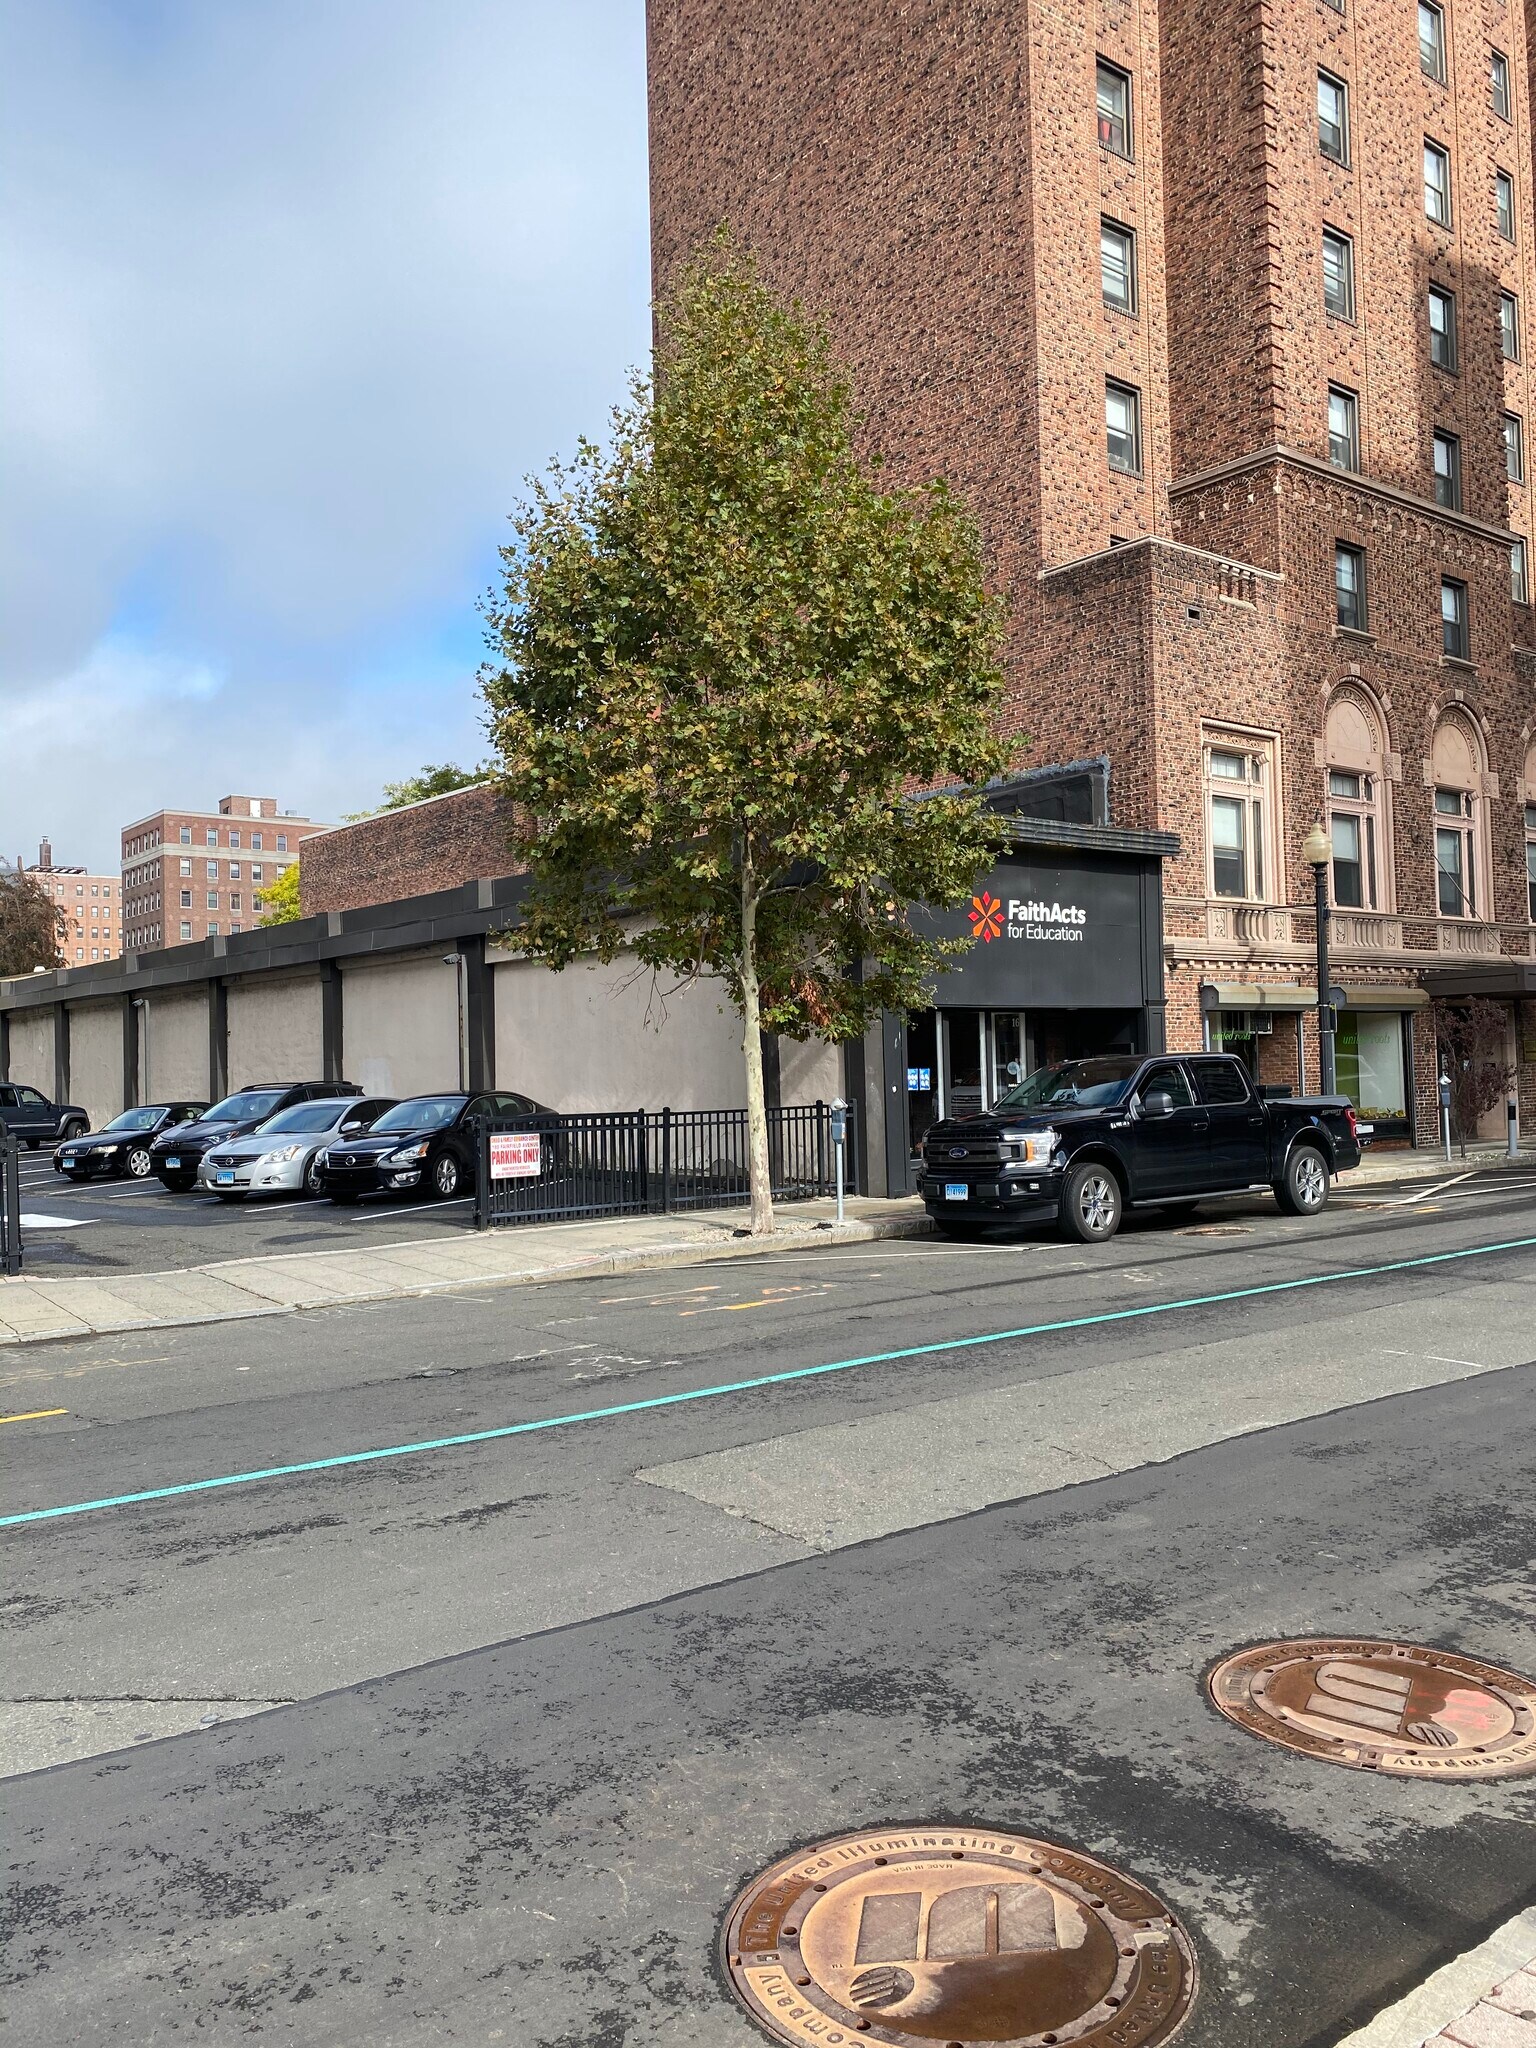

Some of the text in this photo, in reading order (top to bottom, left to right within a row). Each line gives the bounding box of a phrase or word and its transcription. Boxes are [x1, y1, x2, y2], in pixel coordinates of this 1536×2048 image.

[1008, 899, 1087, 924] FaithActs
[1007, 922, 1083, 941] for Education
[492, 1149, 539, 1165] PARKING ONLY
[1393, 1754, 1514, 1770] Company
[745, 1834, 1142, 1947] The United Illuminating Company
